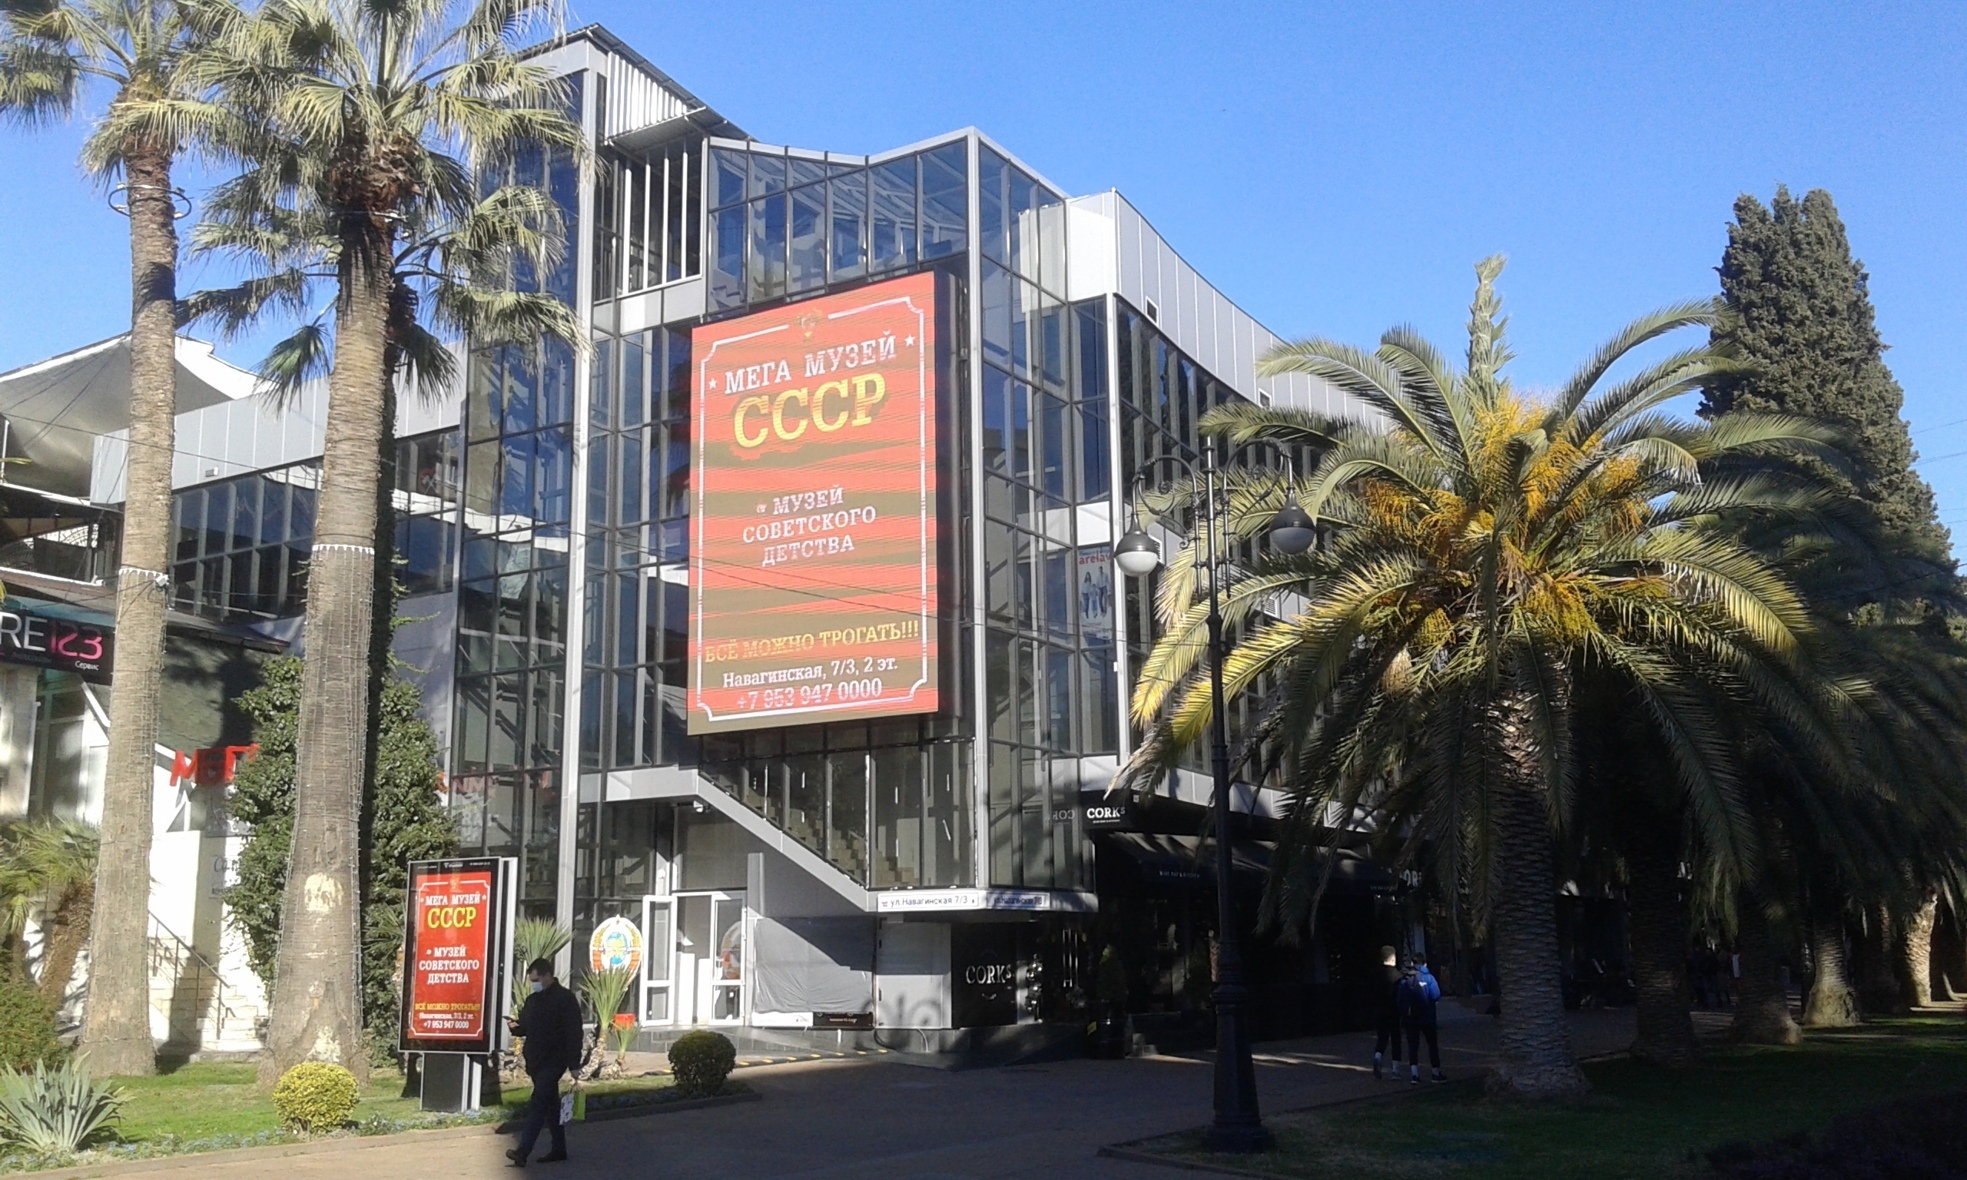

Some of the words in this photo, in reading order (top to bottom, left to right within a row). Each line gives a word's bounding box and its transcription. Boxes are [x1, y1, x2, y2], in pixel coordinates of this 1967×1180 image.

[724, 359, 792, 395] МЕГА
[804, 330, 897, 377] МУЗЕЙ
[734, 373, 886, 448] СССР
[773, 484, 844, 515] МУЗЕЙ
[743, 506, 876, 543] СОВЕТСКОГО
[762, 534, 855, 567] ДЕТСТВА
[705, 638, 739, 663] ВСЁ
[742, 633, 815, 658] МОЖНО
[819, 620, 919, 648] ТРОГАТЬ!!!
[723, 664, 827, 689] Навагинская,
[830, 659, 859, 677] 7/3,
[864, 657, 873, 673] 2
[877, 657, 898, 672] эт.
[737, 690, 758, 710] +7
[764, 688, 795, 709] 953
[800, 684, 833, 705] 947
[837, 677, 883, 700] 0000
[425, 895, 448, 906] МЕГА
[452, 891, 481, 905] МУЗЕЙ
[902, 896, 952, 907] Навагинская
[955, 895, 968, 905] 7/3
[427, 906, 477, 928] СССР
[419, 959, 480, 971] СОВЕТСКОГО
[434, 945, 466, 957] МУЗЕЙ
[427, 973, 469, 985] ДЕТСТВА
[455, 1020, 469, 1028] 0000
